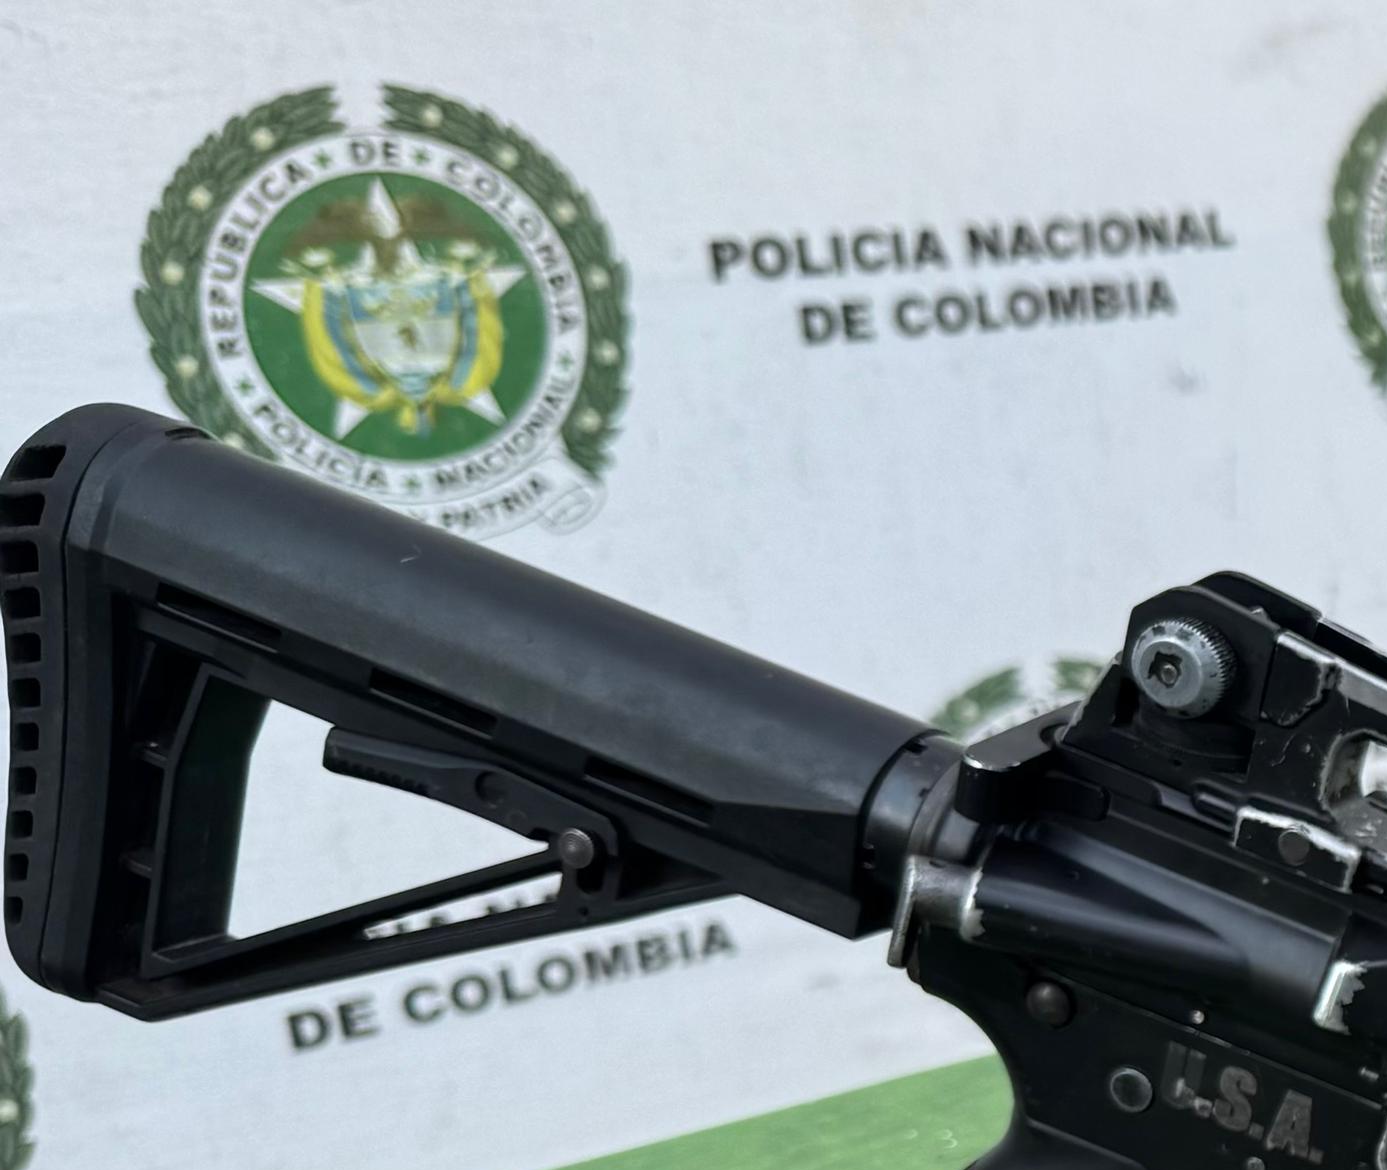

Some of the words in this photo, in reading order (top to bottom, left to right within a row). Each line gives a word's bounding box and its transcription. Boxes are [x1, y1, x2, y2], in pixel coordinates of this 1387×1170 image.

[349, 141, 398, 167] DE
[708, 225, 948, 283] POLICIA
[963, 207, 1236, 266] NACIONAL
[799, 302, 874, 346] DE
[894, 276, 1177, 338] COLOMBIA
[285, 996, 380, 1053] DE
[400, 920, 740, 1024] COLOMBIA
